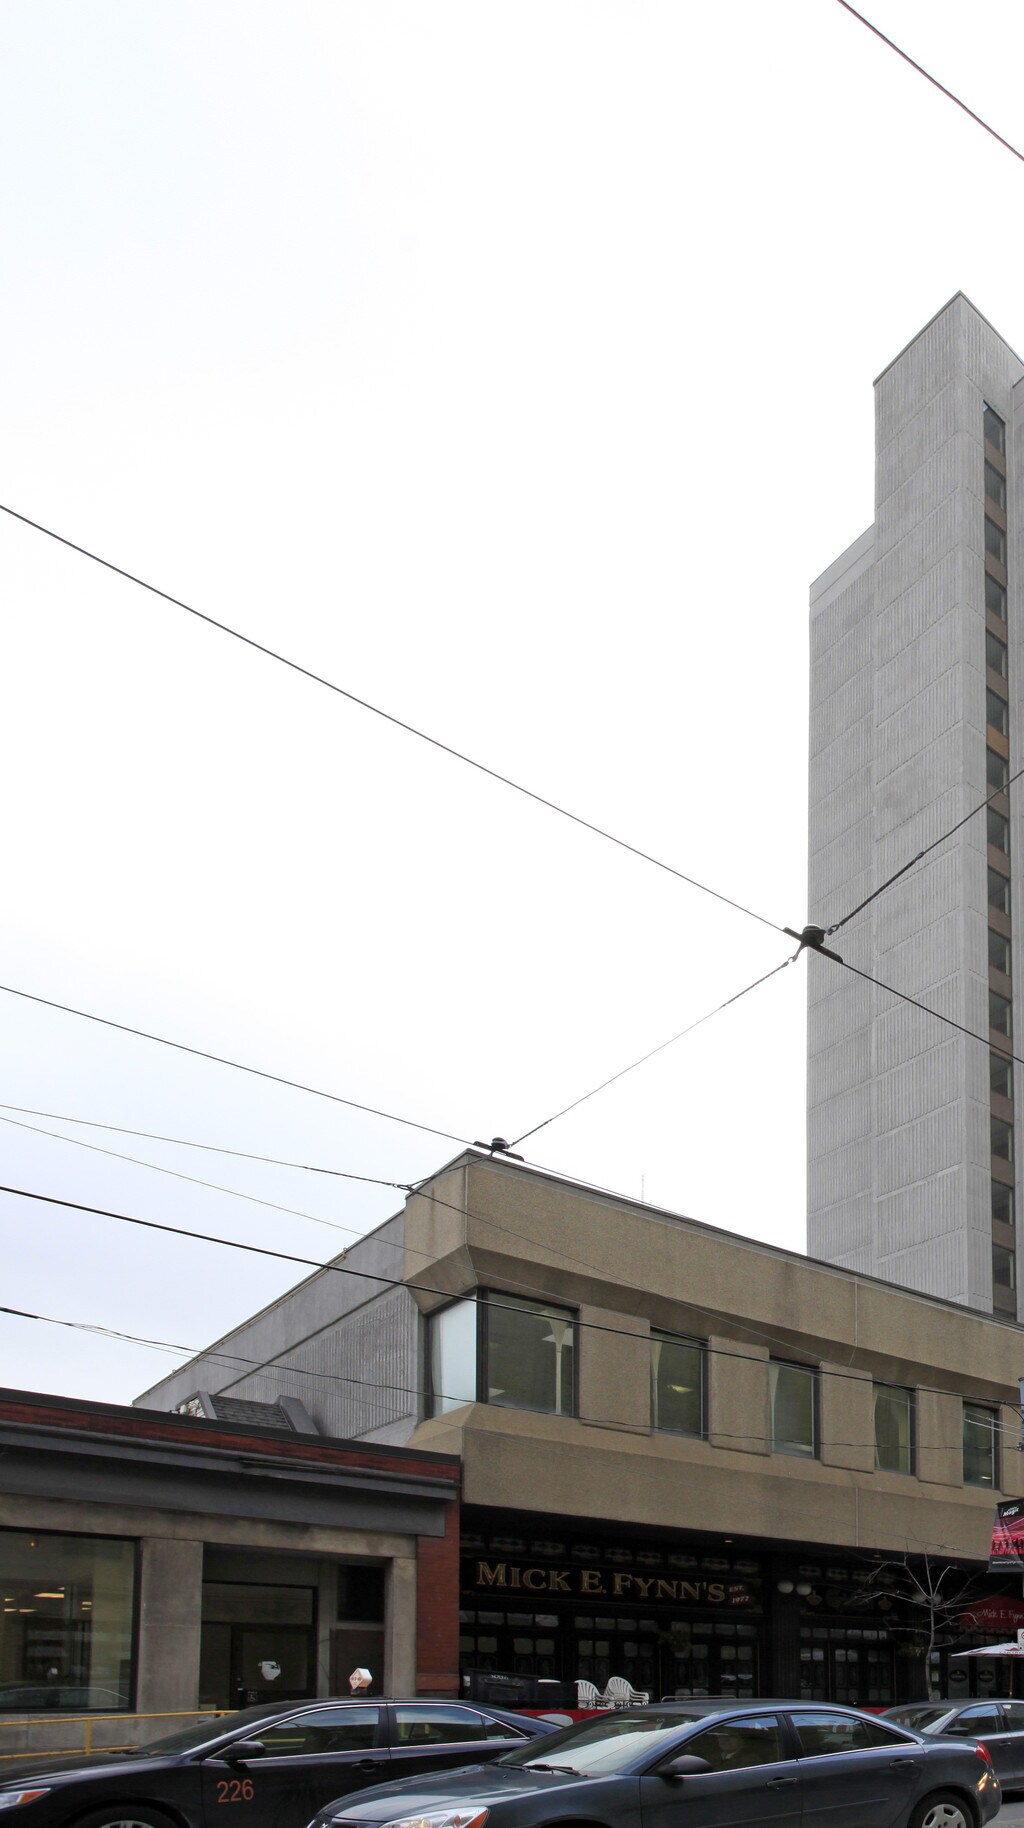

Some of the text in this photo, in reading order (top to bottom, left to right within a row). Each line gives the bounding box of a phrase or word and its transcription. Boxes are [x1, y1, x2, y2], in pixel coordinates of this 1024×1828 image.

[476, 1561, 726, 1602] MICK E. FYNN'S
[216, 1779, 254, 1803] 226
